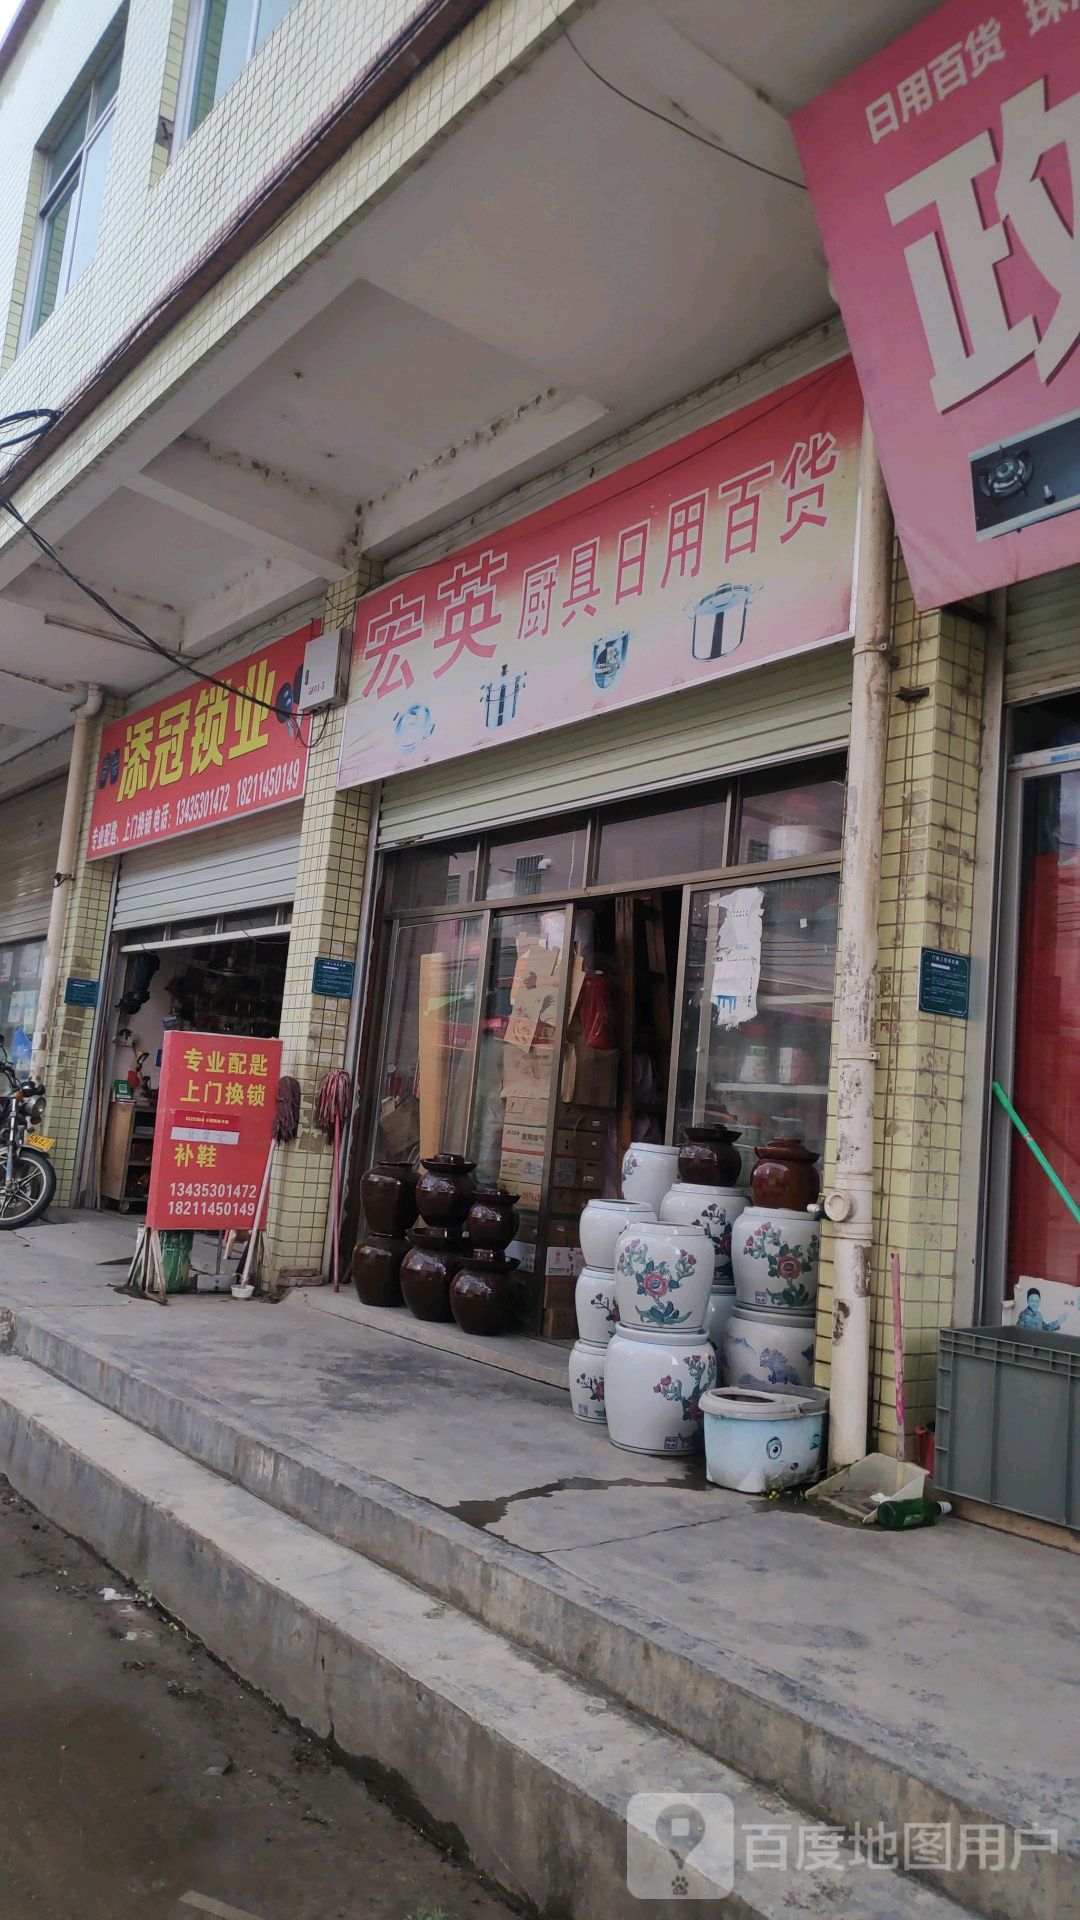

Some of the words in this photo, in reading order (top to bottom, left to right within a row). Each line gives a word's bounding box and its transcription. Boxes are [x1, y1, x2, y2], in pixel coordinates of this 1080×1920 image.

[865, 17, 1006, 144] 日用百货
[116, 659, 276, 802] 添冠锁业
[236, 758, 300, 808] 18211450149
[184, 1048, 268, 1077] 专业配匙
[180, 1079, 265, 1107] 上门换锁
[174, 1143, 217, 1168] 补鞋
[169, 1182, 257, 1199] 13435301472
[168, 1200, 255, 1217] 18211450149
